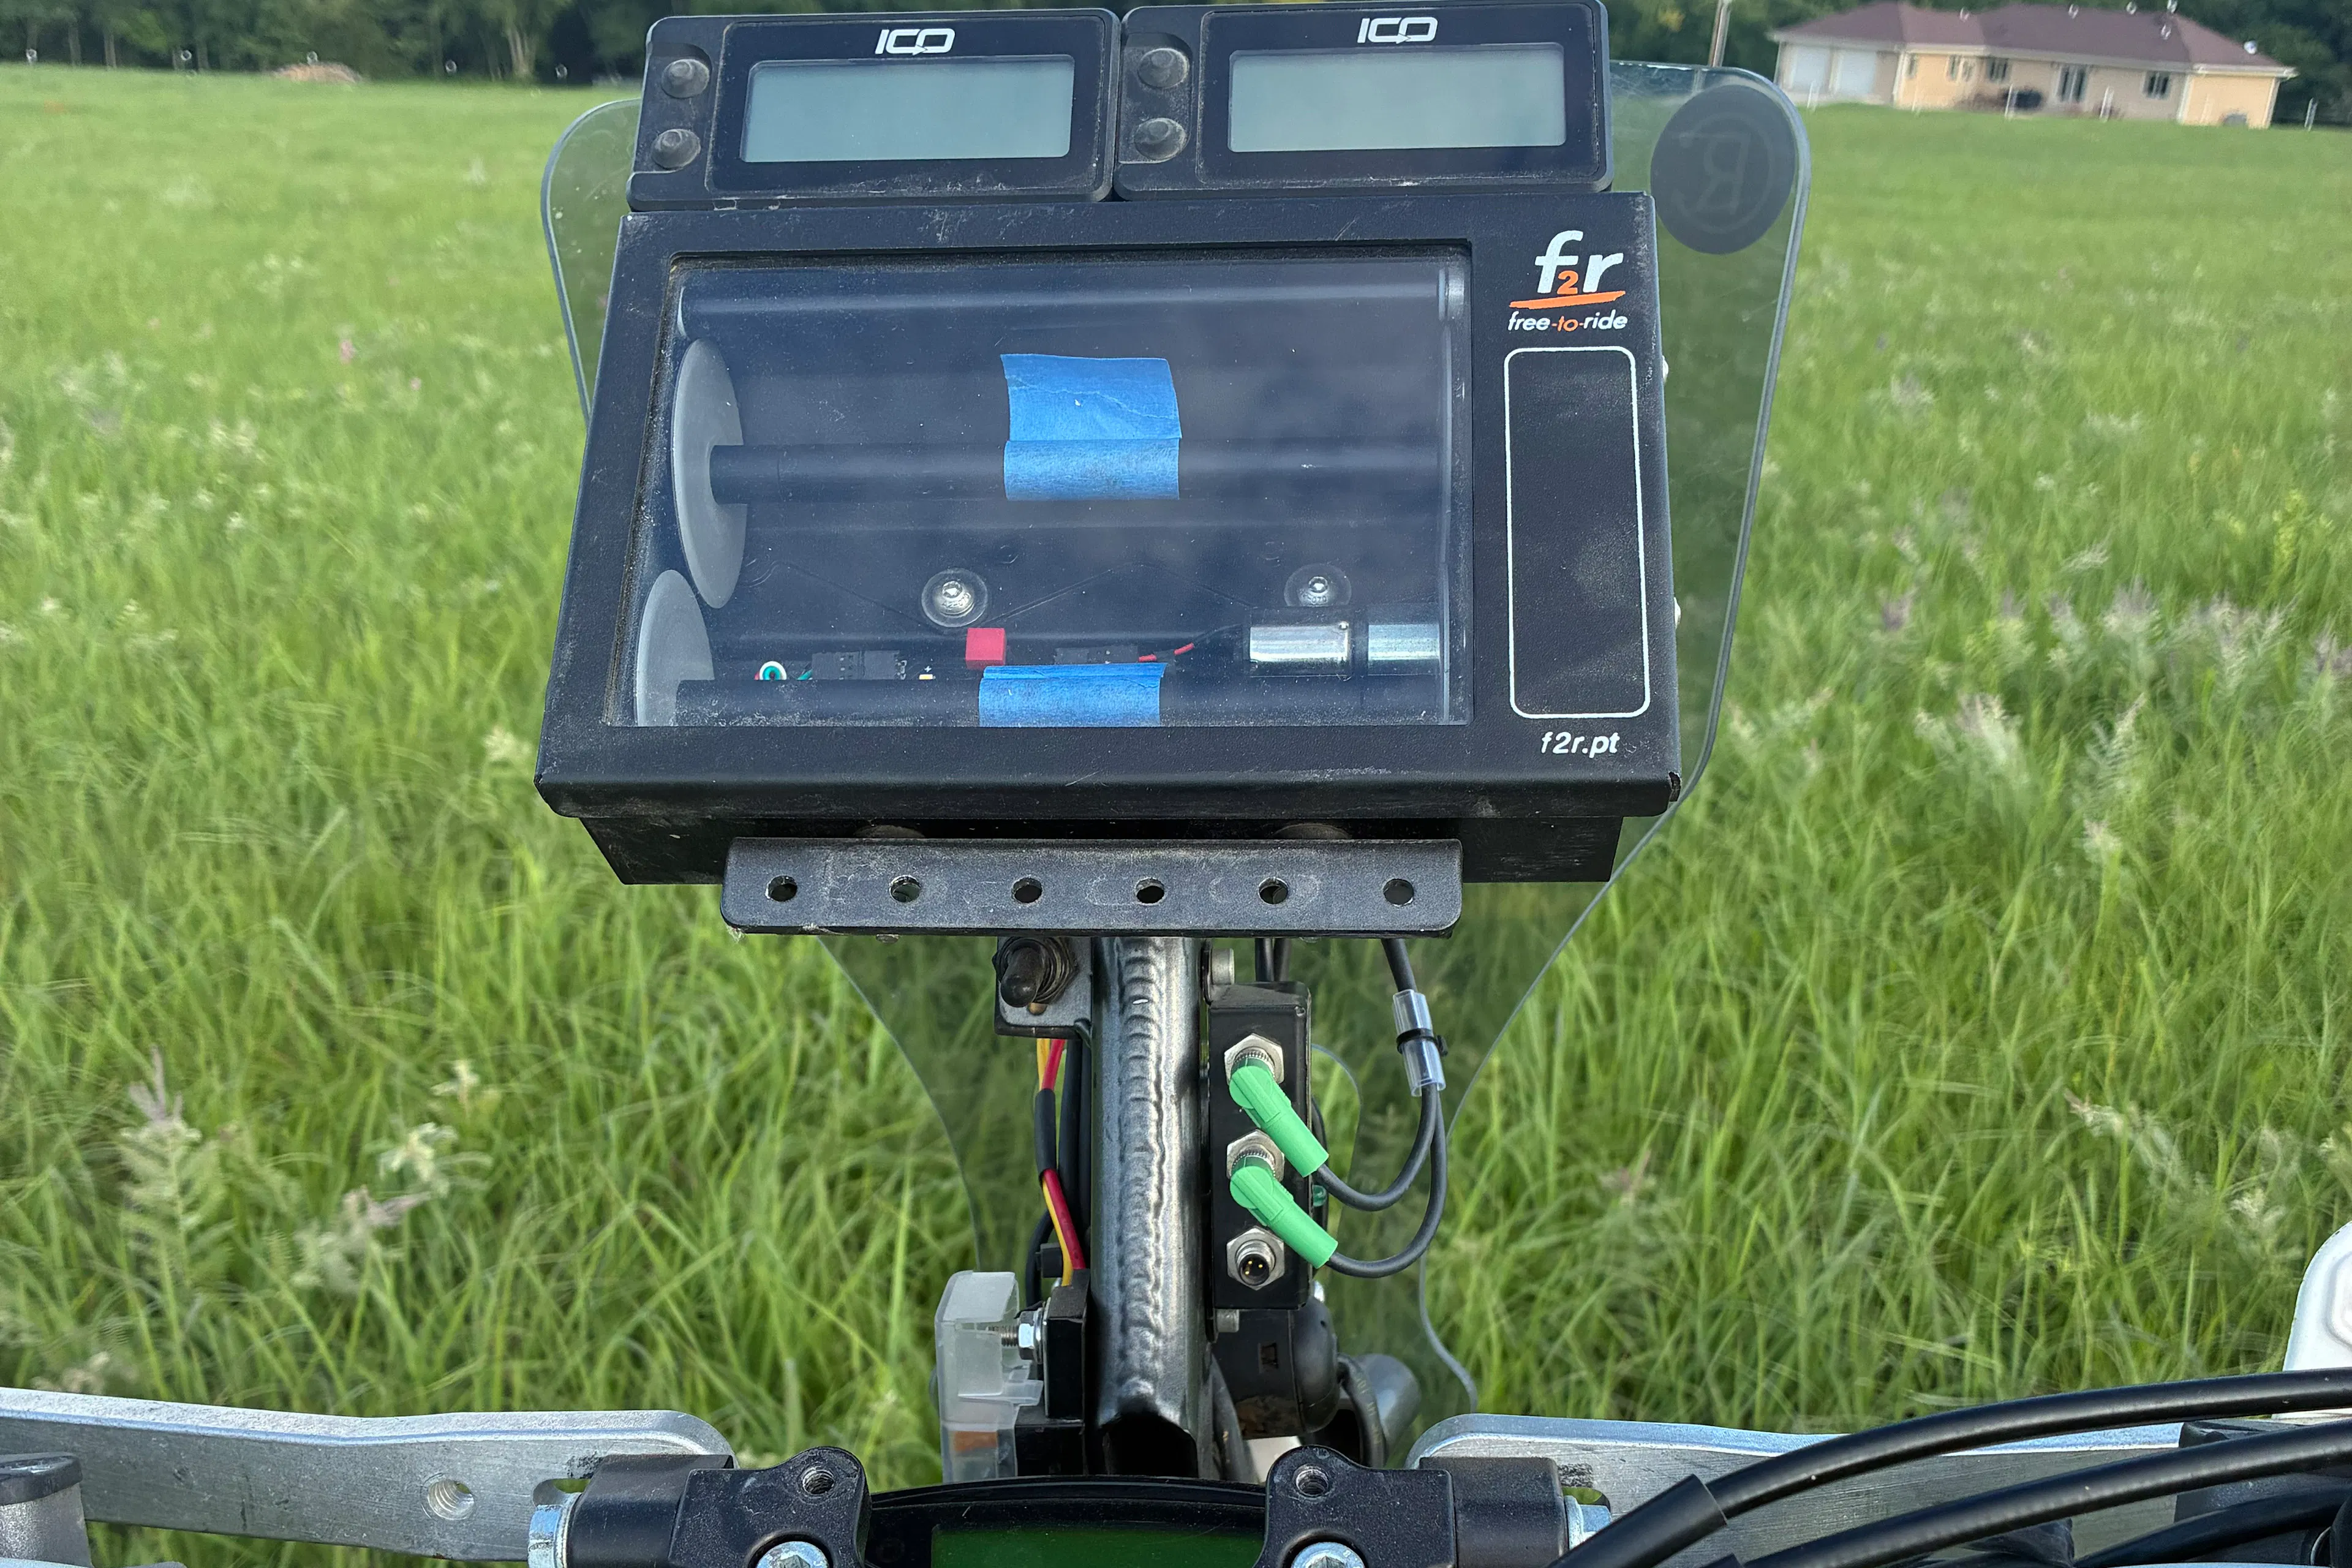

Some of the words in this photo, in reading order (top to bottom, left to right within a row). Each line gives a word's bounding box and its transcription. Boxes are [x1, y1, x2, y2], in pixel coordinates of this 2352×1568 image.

[875, 28, 956, 56] ICO
[1357, 17, 1438, 44] ICO
[1534, 229, 1624, 295] f2r
[1507, 309, 1629, 333] free-to-ride
[1541, 731, 1621, 760] f2r.pt
